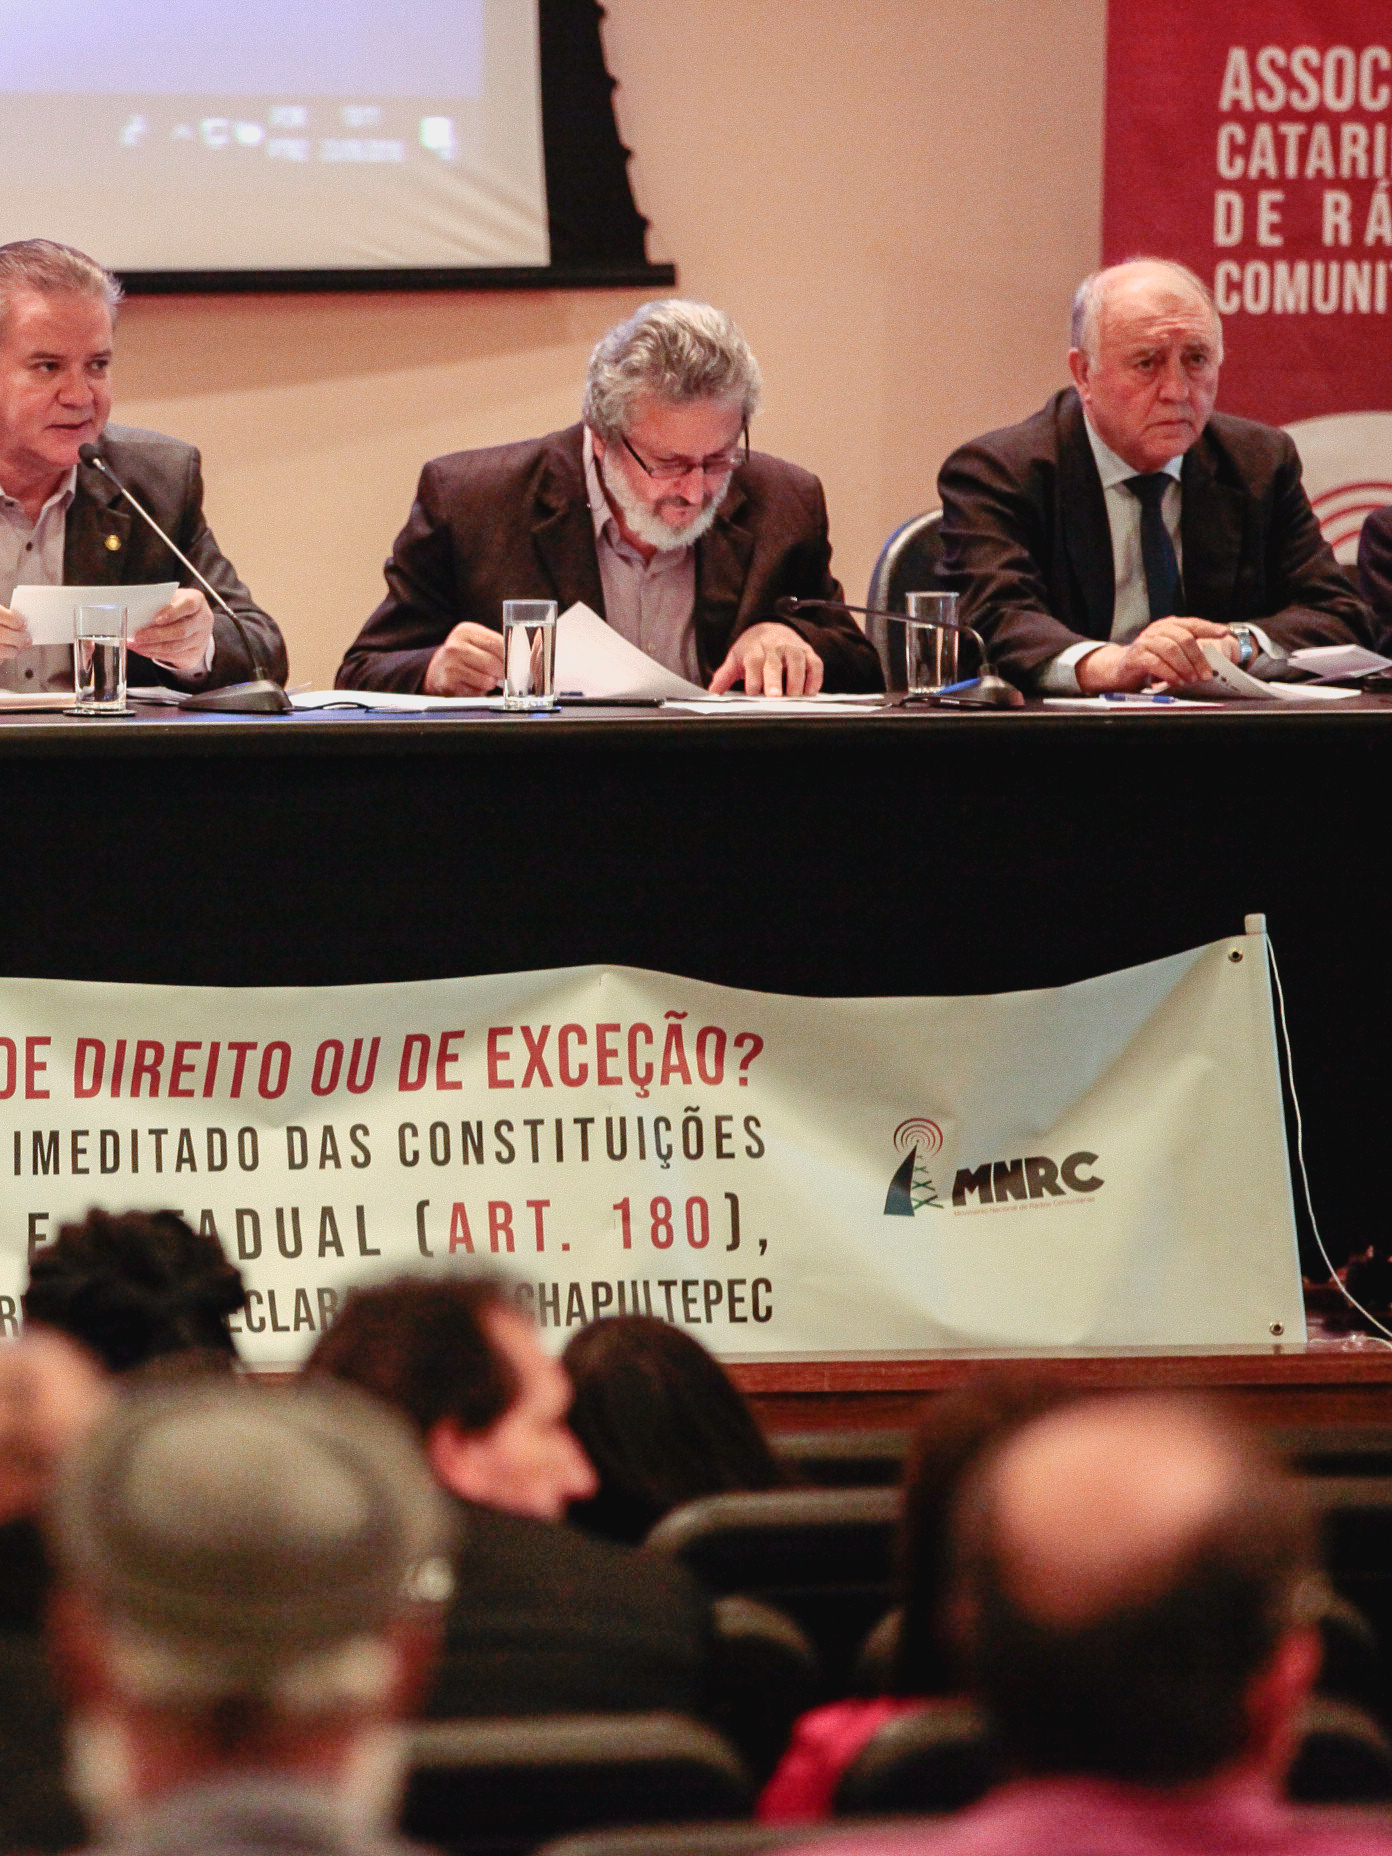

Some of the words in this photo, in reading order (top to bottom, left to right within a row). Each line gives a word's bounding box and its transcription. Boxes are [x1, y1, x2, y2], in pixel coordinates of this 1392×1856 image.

[1216, 122, 1392, 180] CATARI
[1214, 189, 1284, 247] DE
[1214, 259, 1392, 315] COMUNI
[73, 1037, 292, 1100] DIREITO
[310, 1036, 382, 1097] OU
[397, 1028, 466, 1093] DE
[486, 1009, 765, 1099] EXCEÇÃO?
[13, 1125, 260, 1177] IMEDITADO
[285, 1123, 372, 1171] DAS
[397, 1105, 766, 1170] CONSTITUIÇÕES
[952, 1151, 1105, 1207] MNRC
[416, 1200, 571, 1257] (ART.
[612, 1191, 768, 1256] 180),
